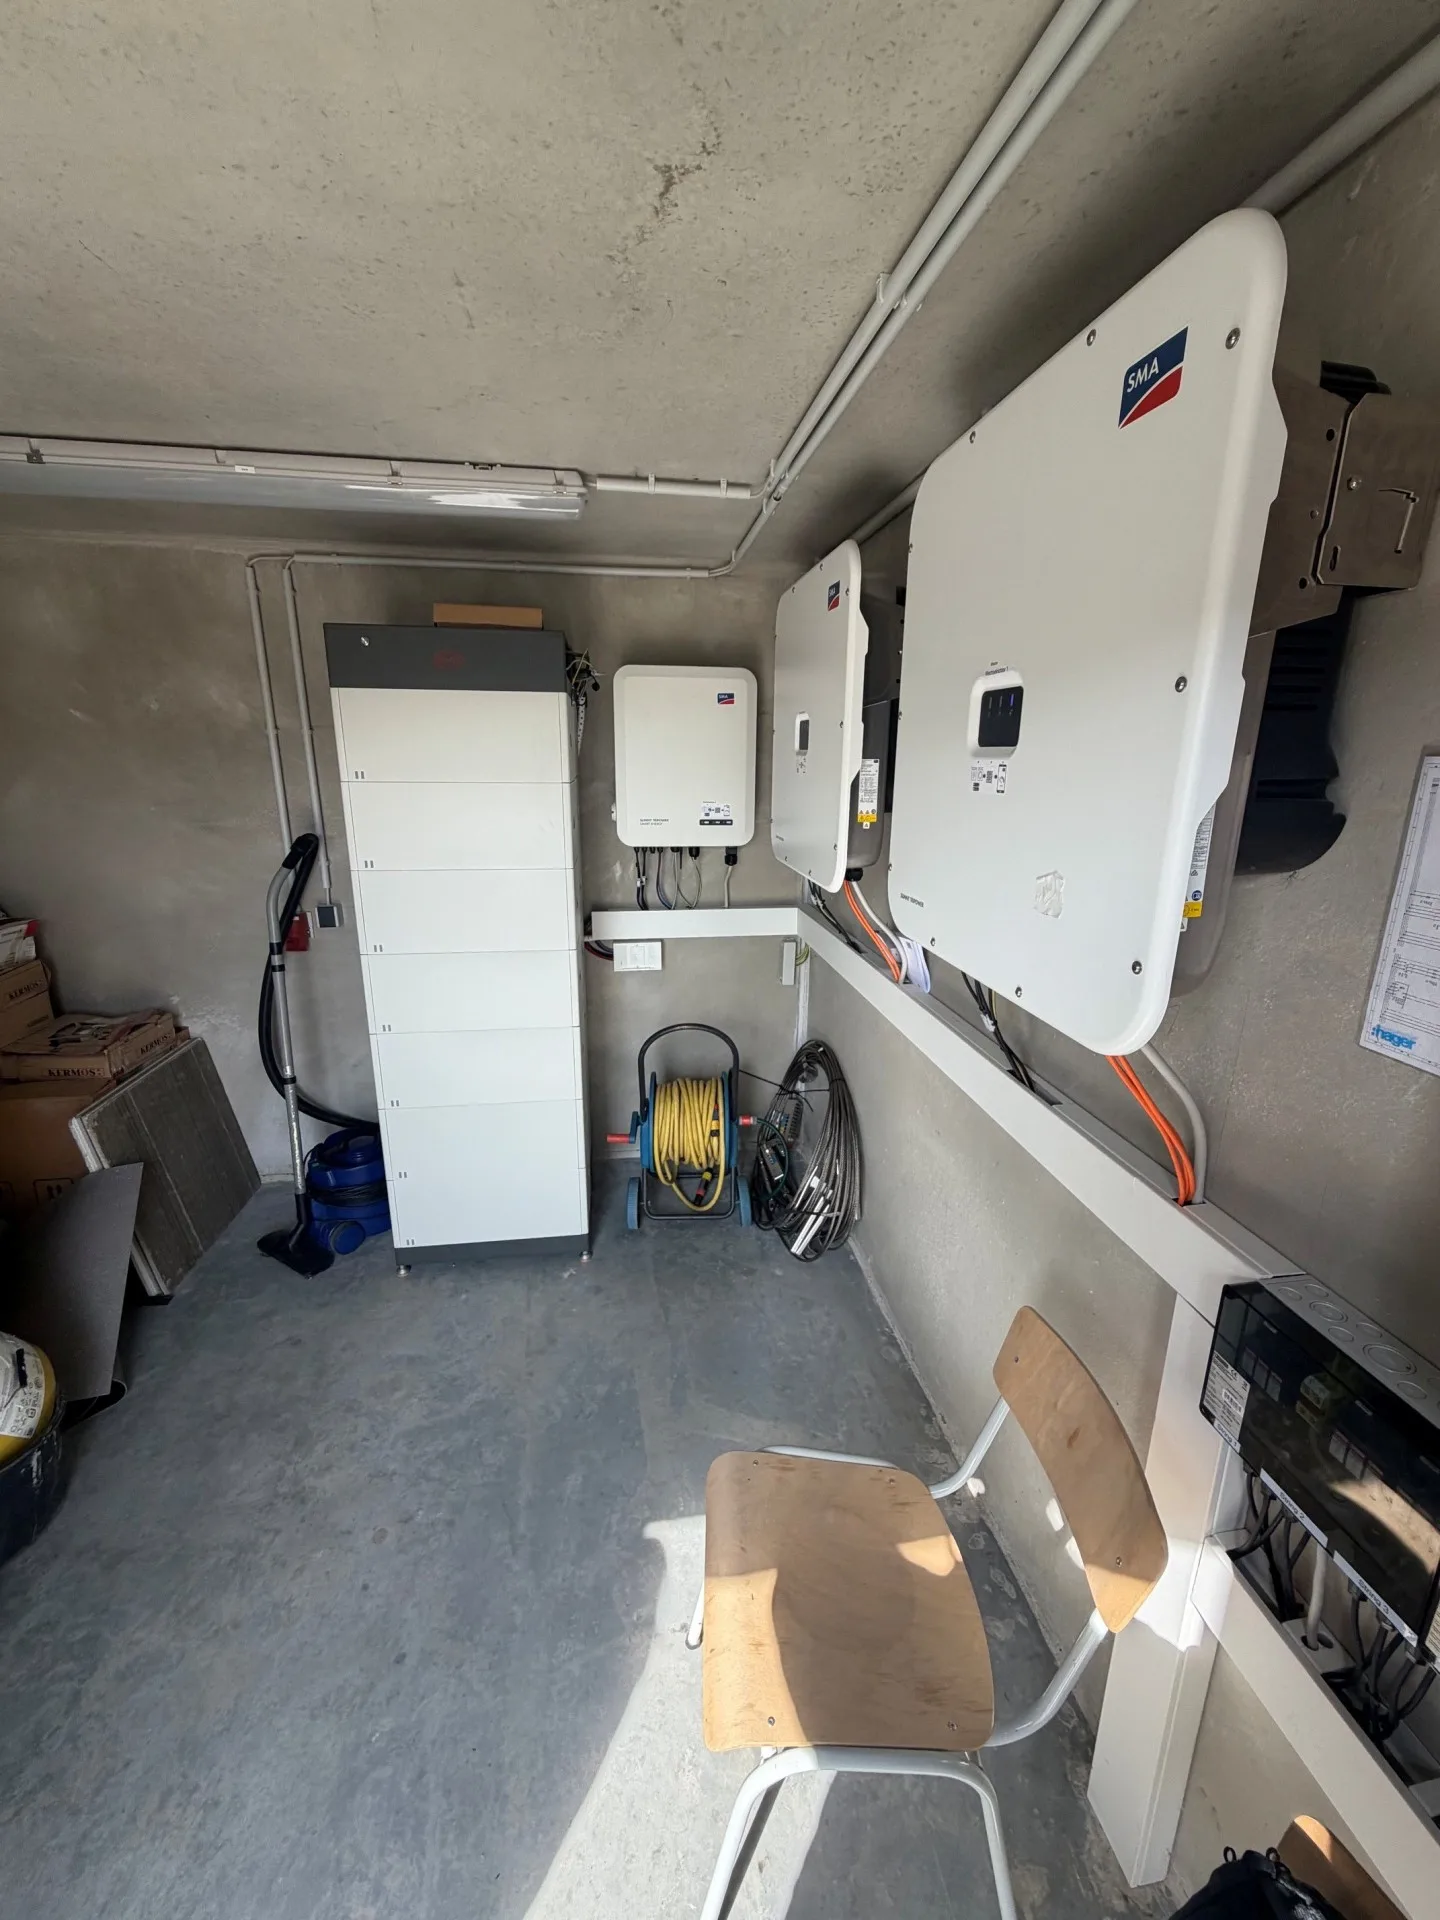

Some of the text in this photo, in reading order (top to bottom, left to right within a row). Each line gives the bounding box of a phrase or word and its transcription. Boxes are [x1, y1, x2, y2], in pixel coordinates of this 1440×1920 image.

[1127, 356, 1159, 393] SMA
[1280, 1491, 1299, 1515] String
[1358, 1578, 1382, 1607] String
